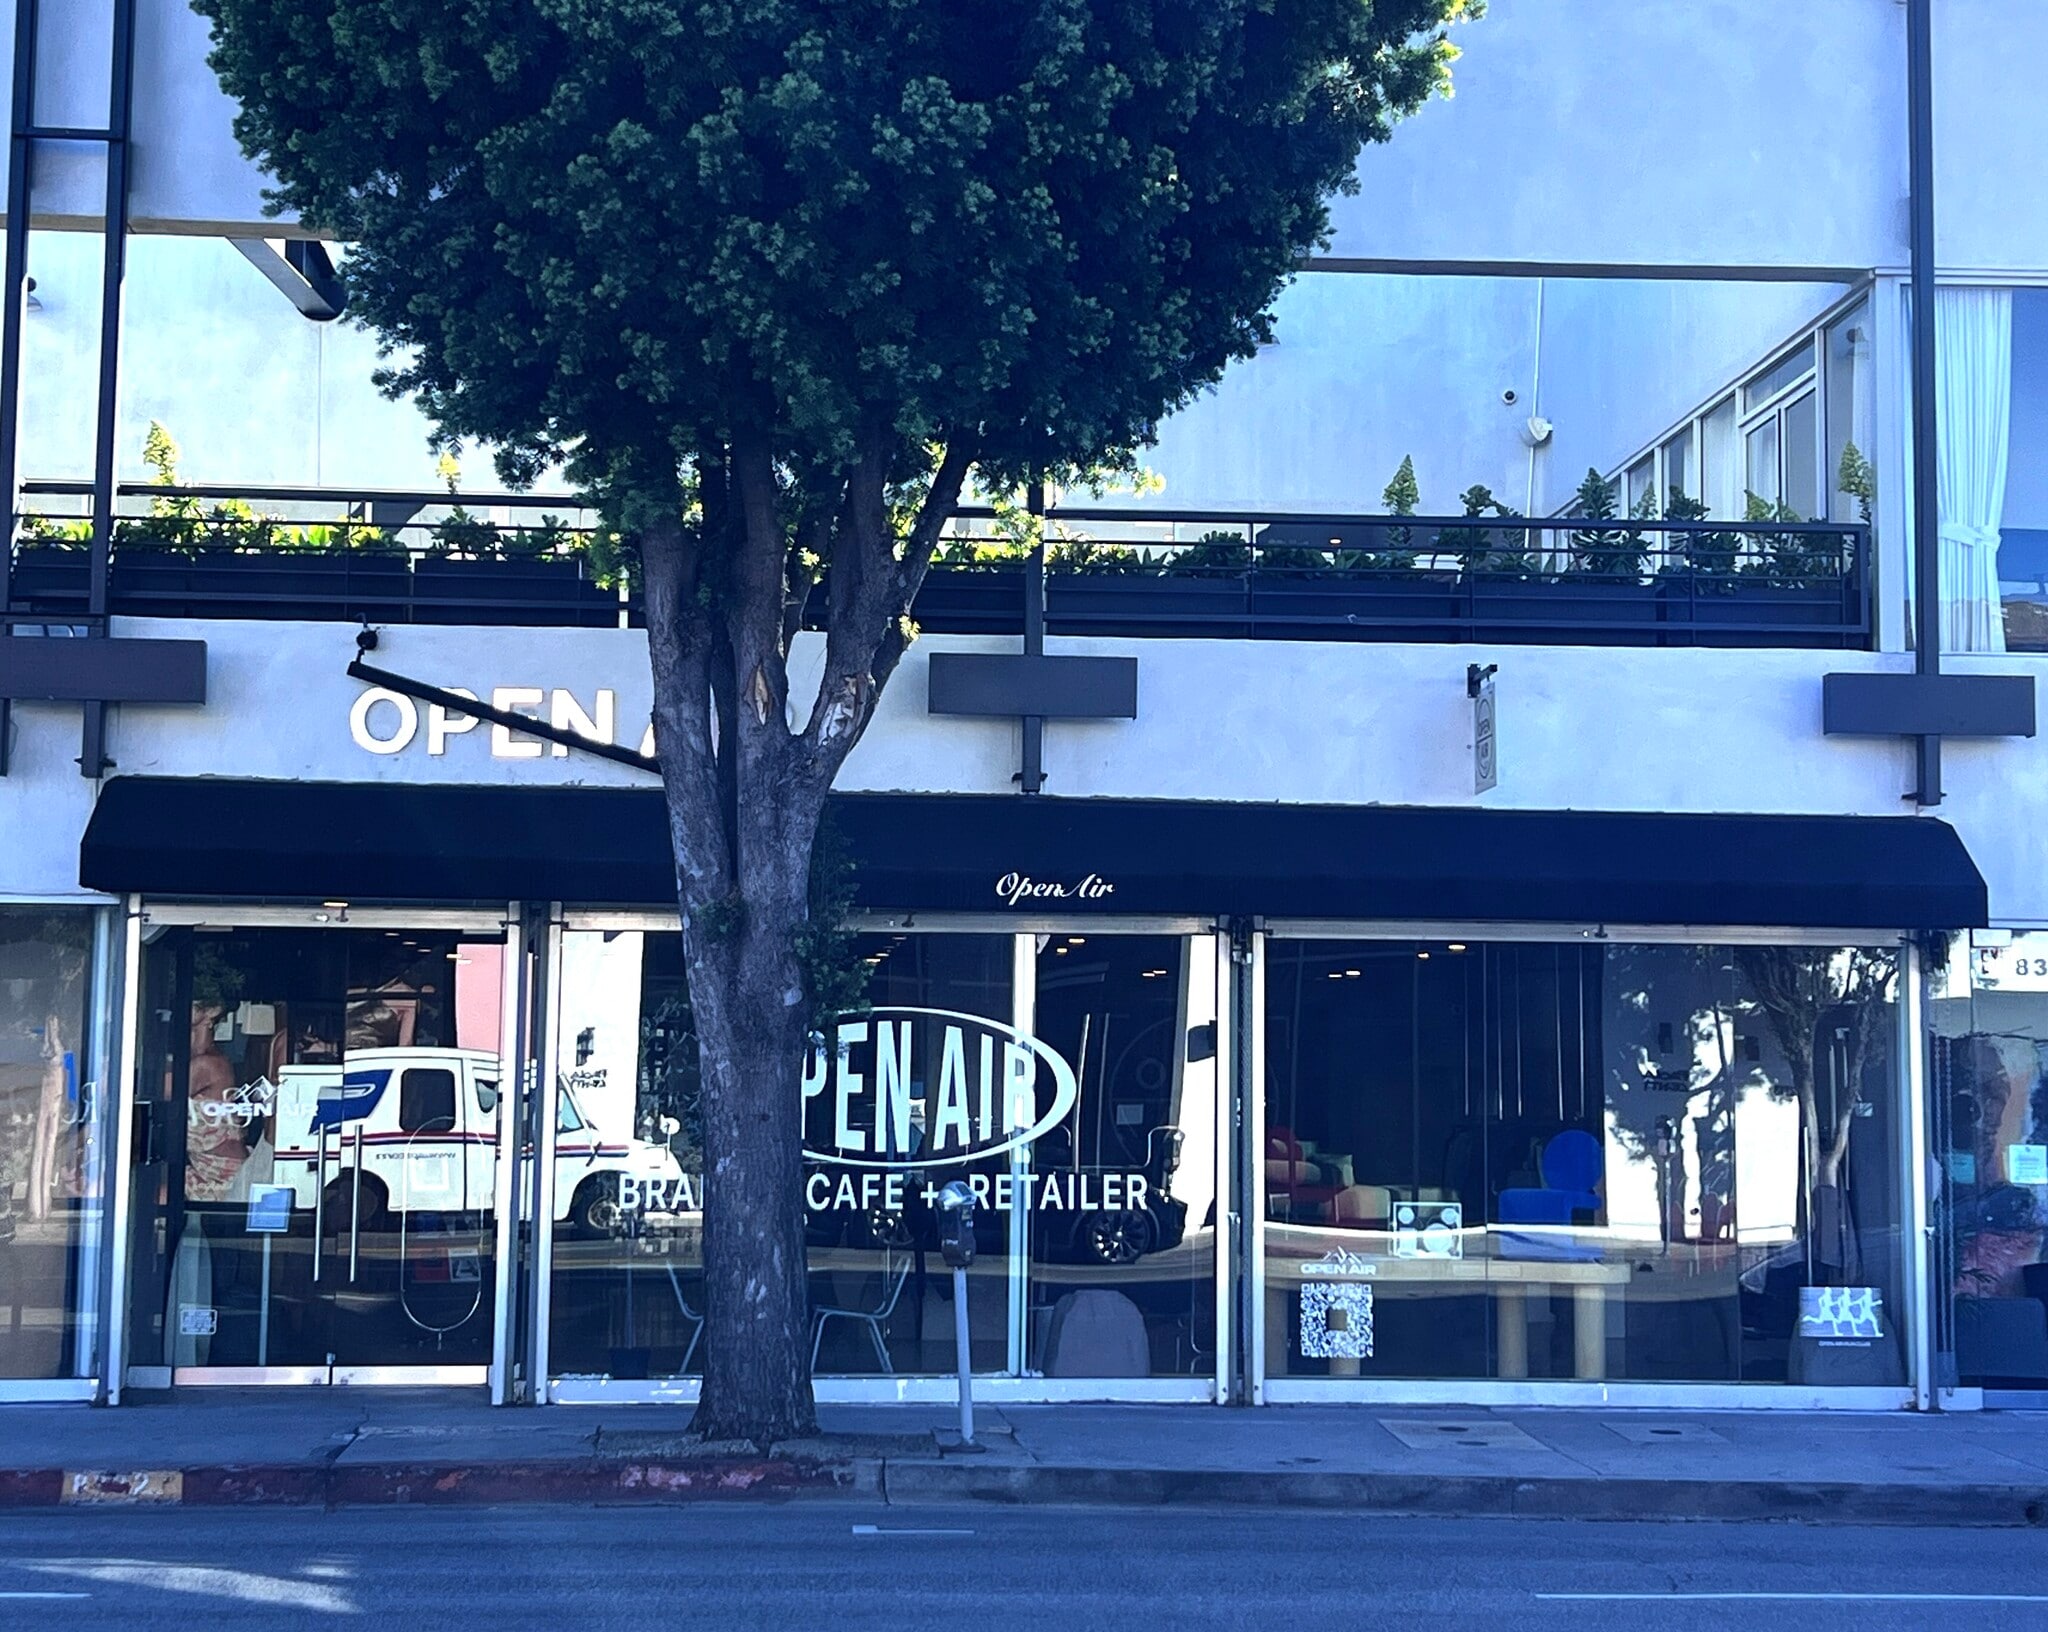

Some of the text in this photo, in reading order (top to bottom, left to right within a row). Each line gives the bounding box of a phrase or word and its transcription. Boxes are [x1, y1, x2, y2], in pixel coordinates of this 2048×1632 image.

[350, 687, 614, 757] OPEN
[995, 872, 1115, 906] Open Air
[801, 1021, 1036, 1153] PEN AIR
[203, 1102, 273, 1117] OPEN
[618, 1173, 704, 1210] BRA
[805, 1173, 904, 1211] CAFE
[969, 1173, 1148, 1211] RETAILER
[1300, 1263, 1377, 1276] OPEN AIR
